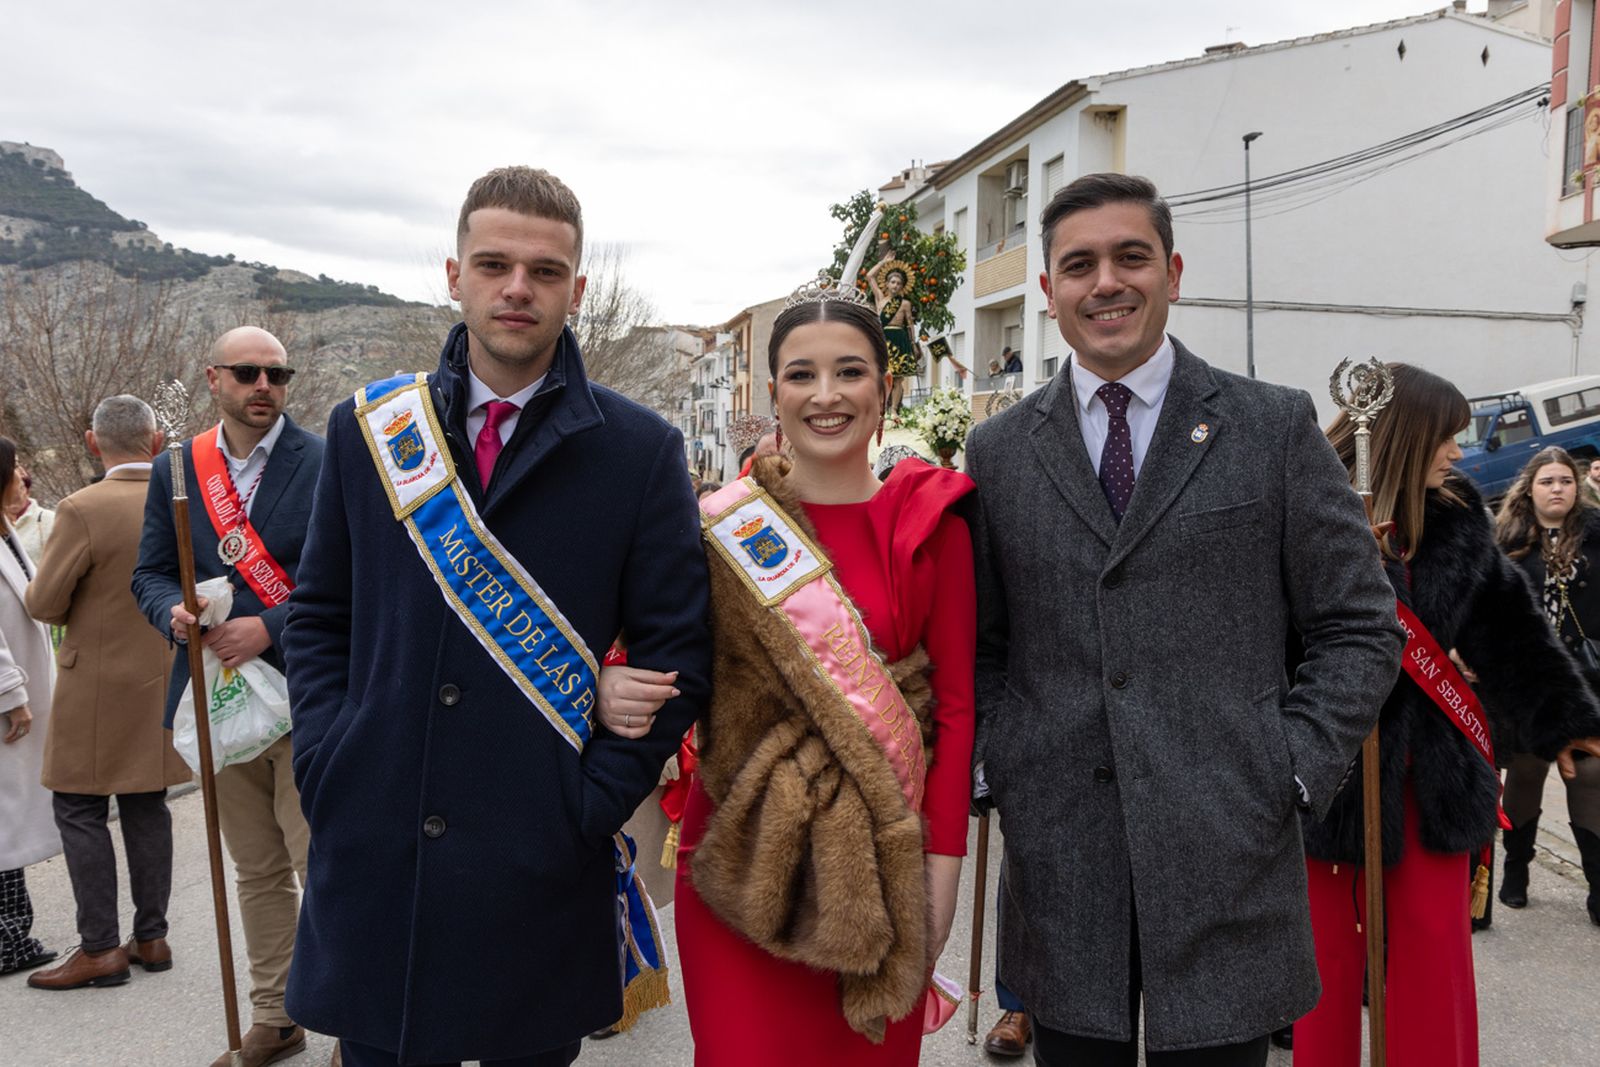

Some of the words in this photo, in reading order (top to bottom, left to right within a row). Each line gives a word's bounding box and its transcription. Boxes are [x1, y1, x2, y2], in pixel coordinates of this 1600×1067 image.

[249, 559, 290, 605] SEBASTI
[439, 523, 513, 620] MISTER
[503, 609, 546, 653] DE
[534, 644, 581, 695] LAS
[821, 623, 884, 705] REINA
[878, 699, 909, 742] DE
[1411, 647, 1441, 680] SAN
